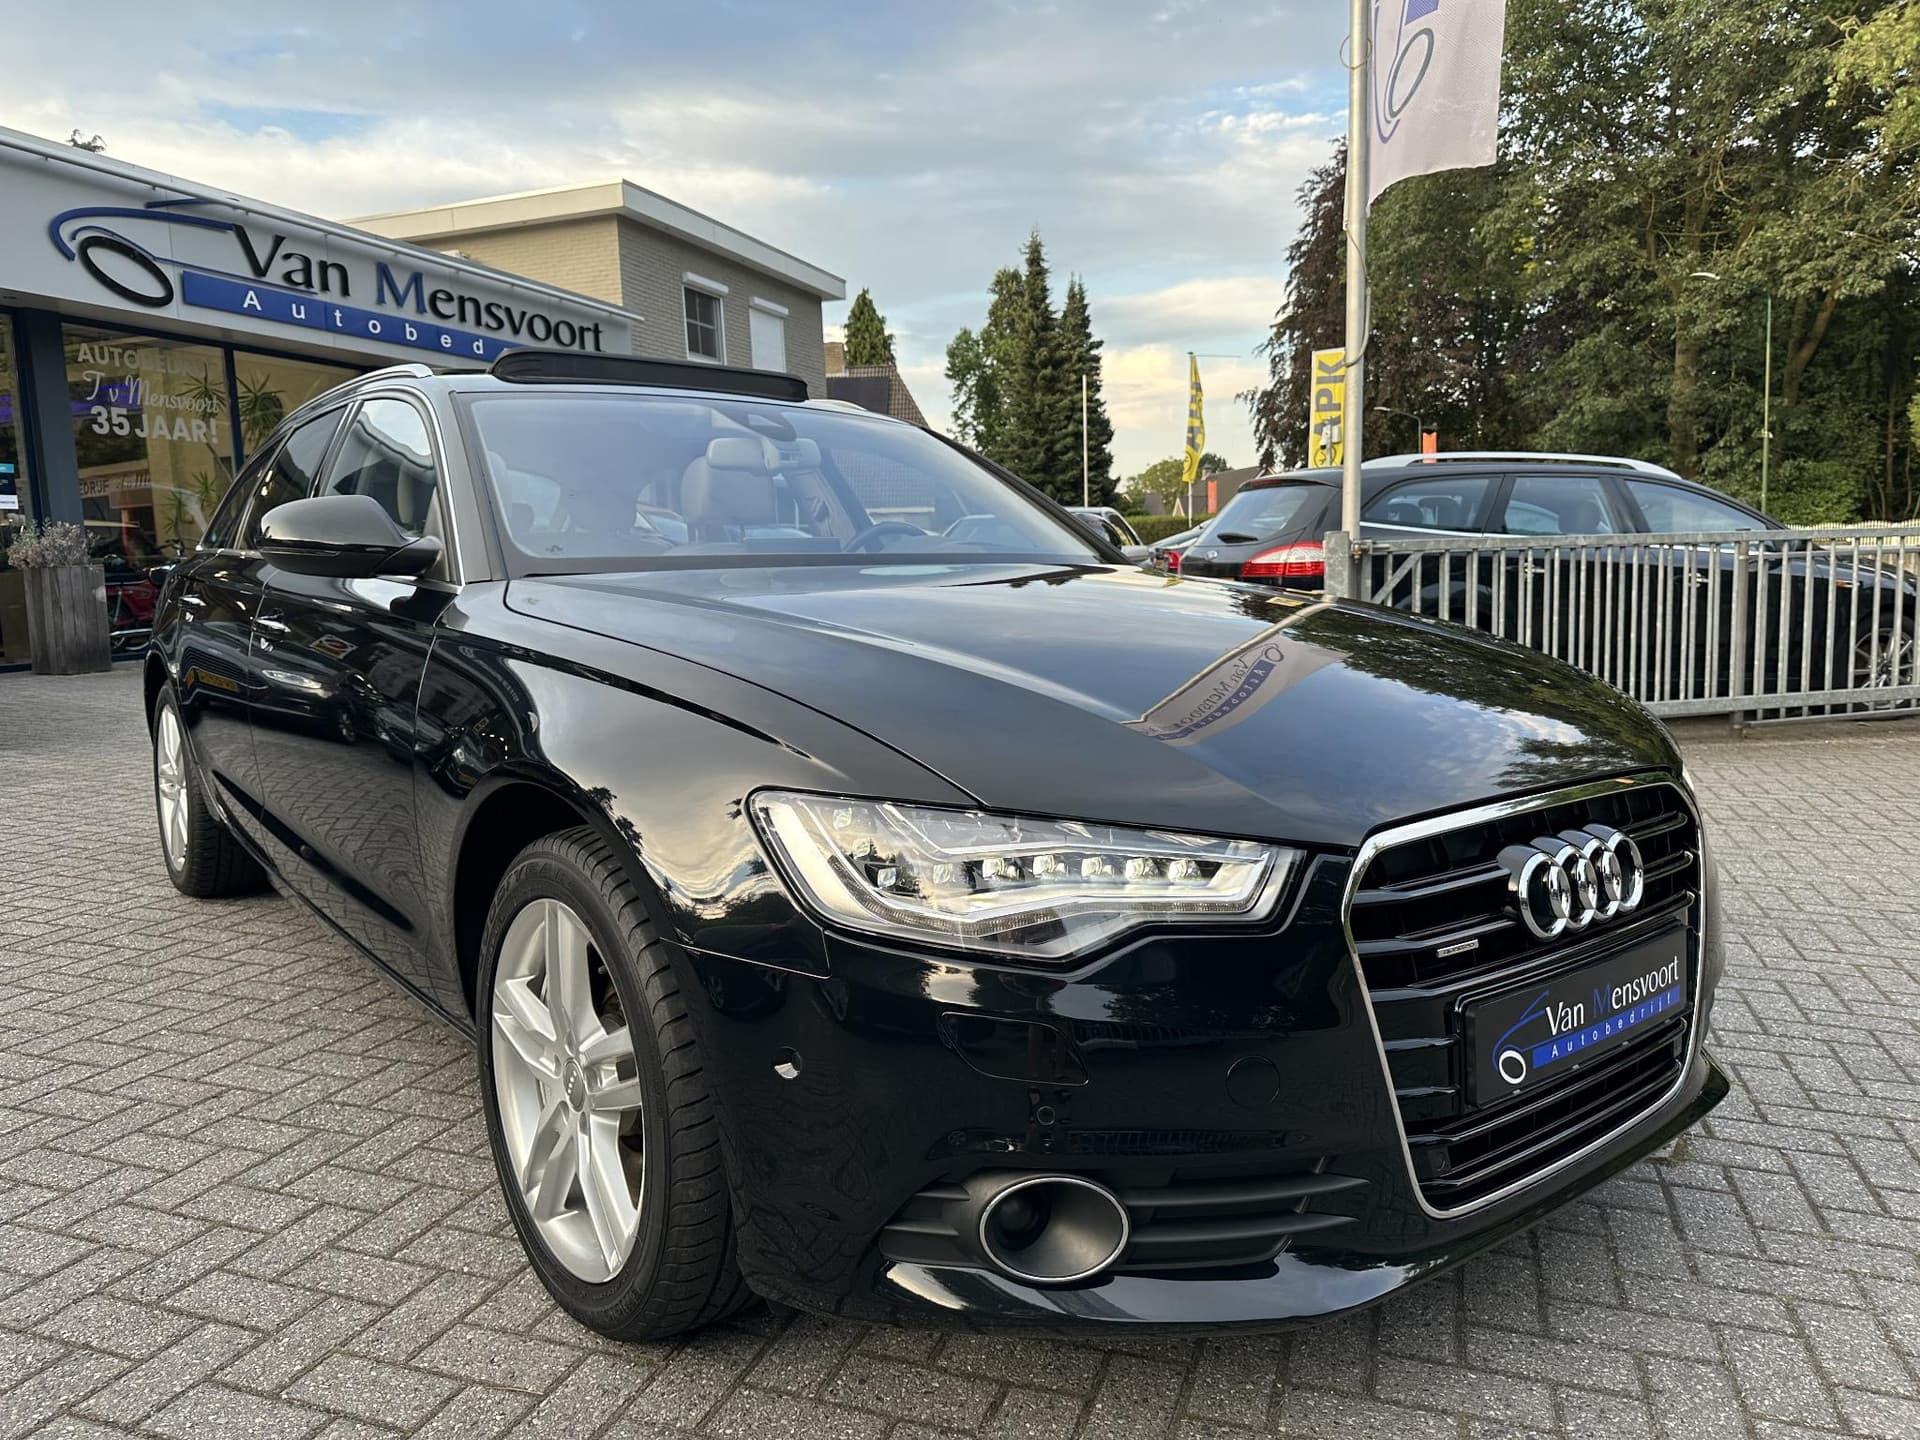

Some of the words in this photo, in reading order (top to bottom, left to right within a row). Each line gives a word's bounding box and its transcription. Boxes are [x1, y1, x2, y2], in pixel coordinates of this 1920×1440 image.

[232, 224, 350, 296] Van
[376, 262, 603, 352] Mensvoort
[243, 290, 484, 354] Autobed
[90, 405, 130, 436] 35
[135, 413, 218, 444] JAAR!
[125, 375, 220, 413] Mensvoort
[1313, 358, 1346, 437] APK
[1546, 1002, 1584, 1036] Van
[1593, 955, 1679, 1018] Mensvoort
[1552, 992, 1671, 1058] Autobedrijf
